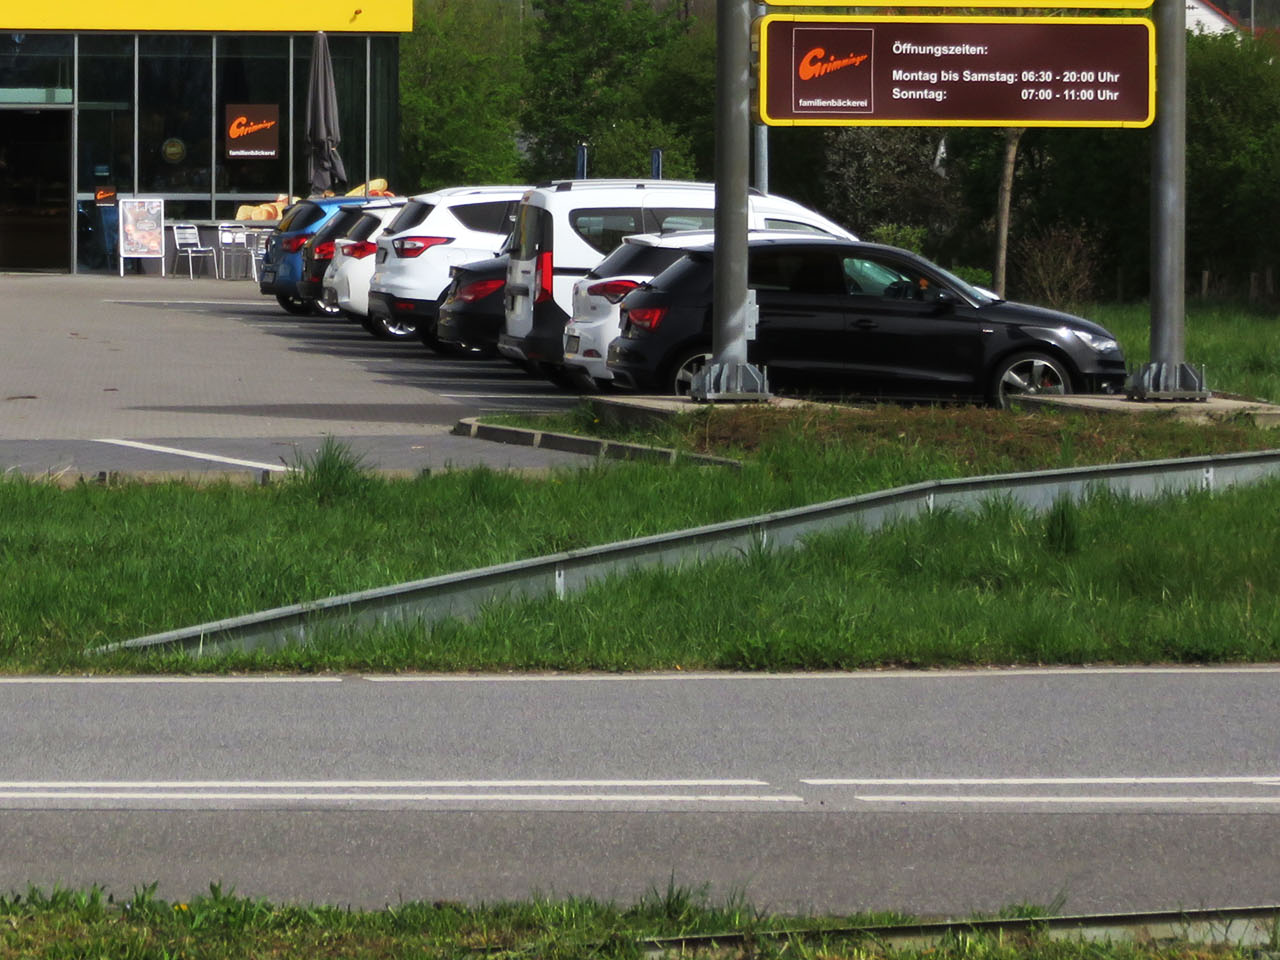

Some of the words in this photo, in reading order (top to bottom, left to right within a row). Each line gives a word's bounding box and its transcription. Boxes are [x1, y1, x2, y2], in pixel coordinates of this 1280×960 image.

[892, 40, 989, 57] Öffnungszeiten:
[892, 70, 938, 84] Montag
[940, 70, 960, 82] bis
[962, 70, 1019, 84] Samstag:
[1021, 71, 1053, 83] 06:30
[1062, 71, 1095, 83] 20:00
[1097, 71, 1120, 83] Uhr
[892, 87, 948, 102] Sonntag:
[1021, 89, 1053, 101] 07:00
[1063, 89, 1095, 101] 11:00
[1097, 89, 1120, 101] Uhr
[798, 98, 868, 107] familienbäckerei
